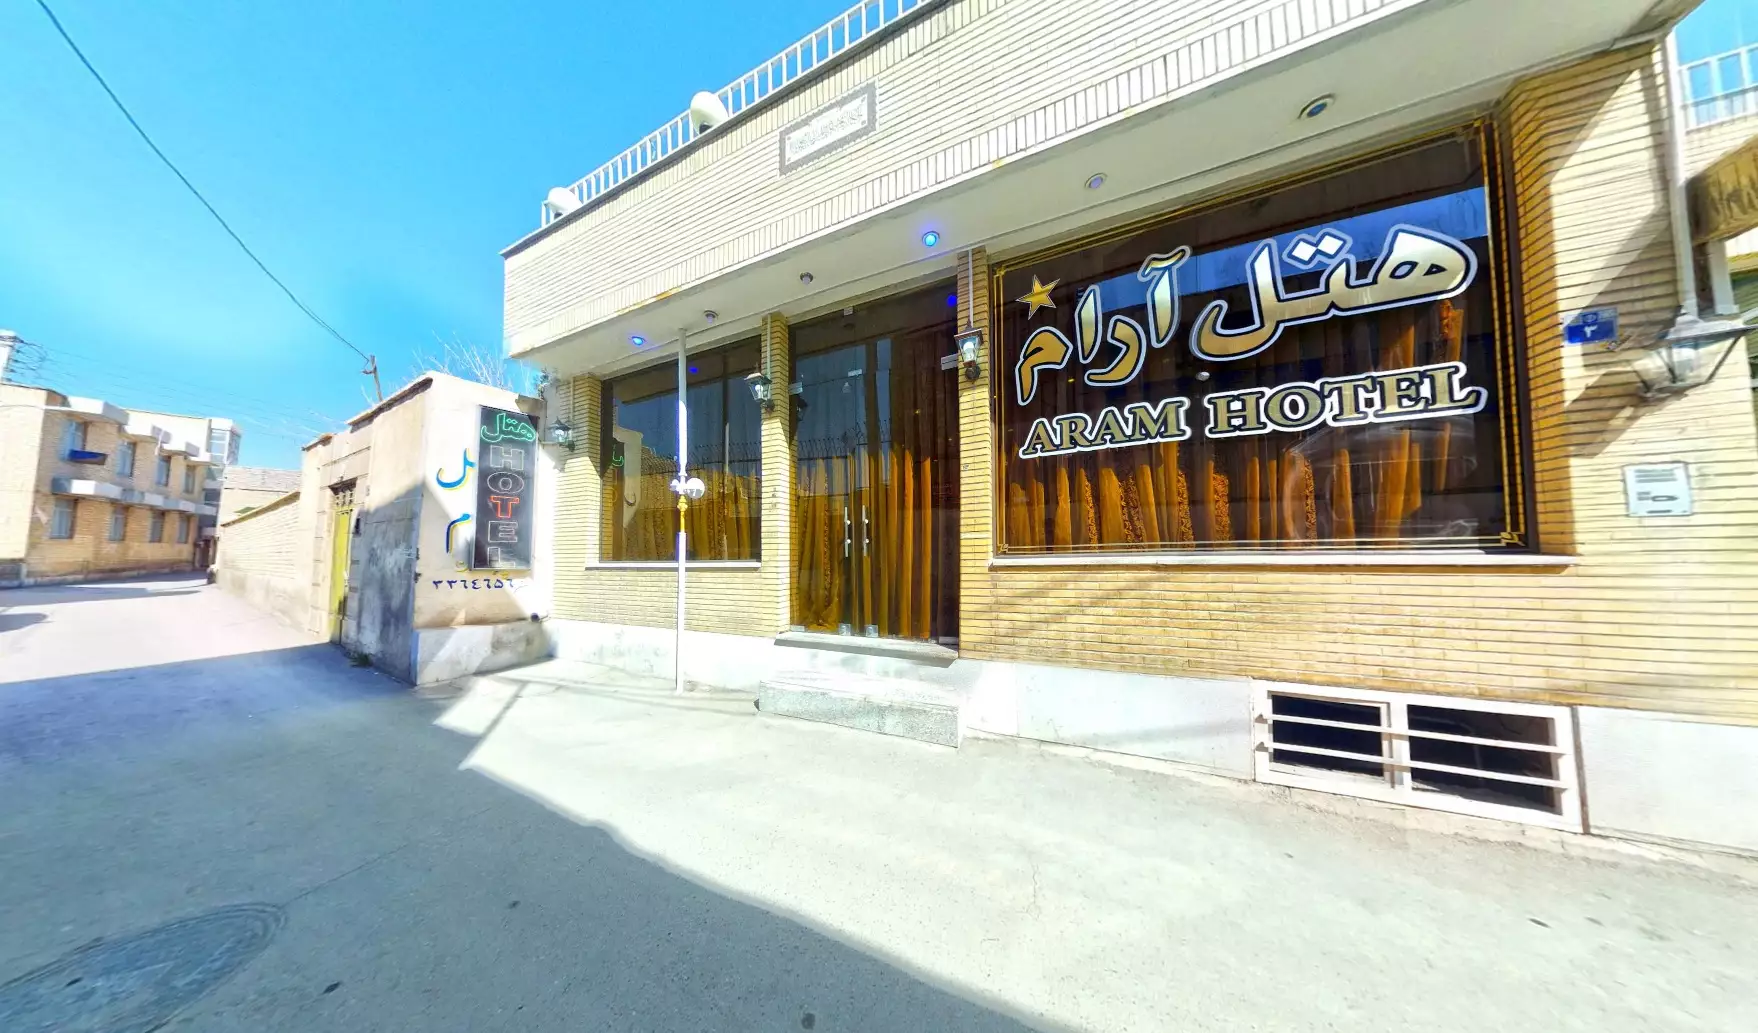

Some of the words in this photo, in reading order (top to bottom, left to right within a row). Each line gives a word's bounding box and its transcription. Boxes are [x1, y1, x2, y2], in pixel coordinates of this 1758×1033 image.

[1015, 245, 1192, 406] آرام
[1189, 223, 1478, 362] هتل
[480, 412, 536, 443] هتل
[1019, 396, 1192, 459] ARAM
[1205, 361, 1488, 438] HOTEL
[486, 444, 525, 568] HOTEL
